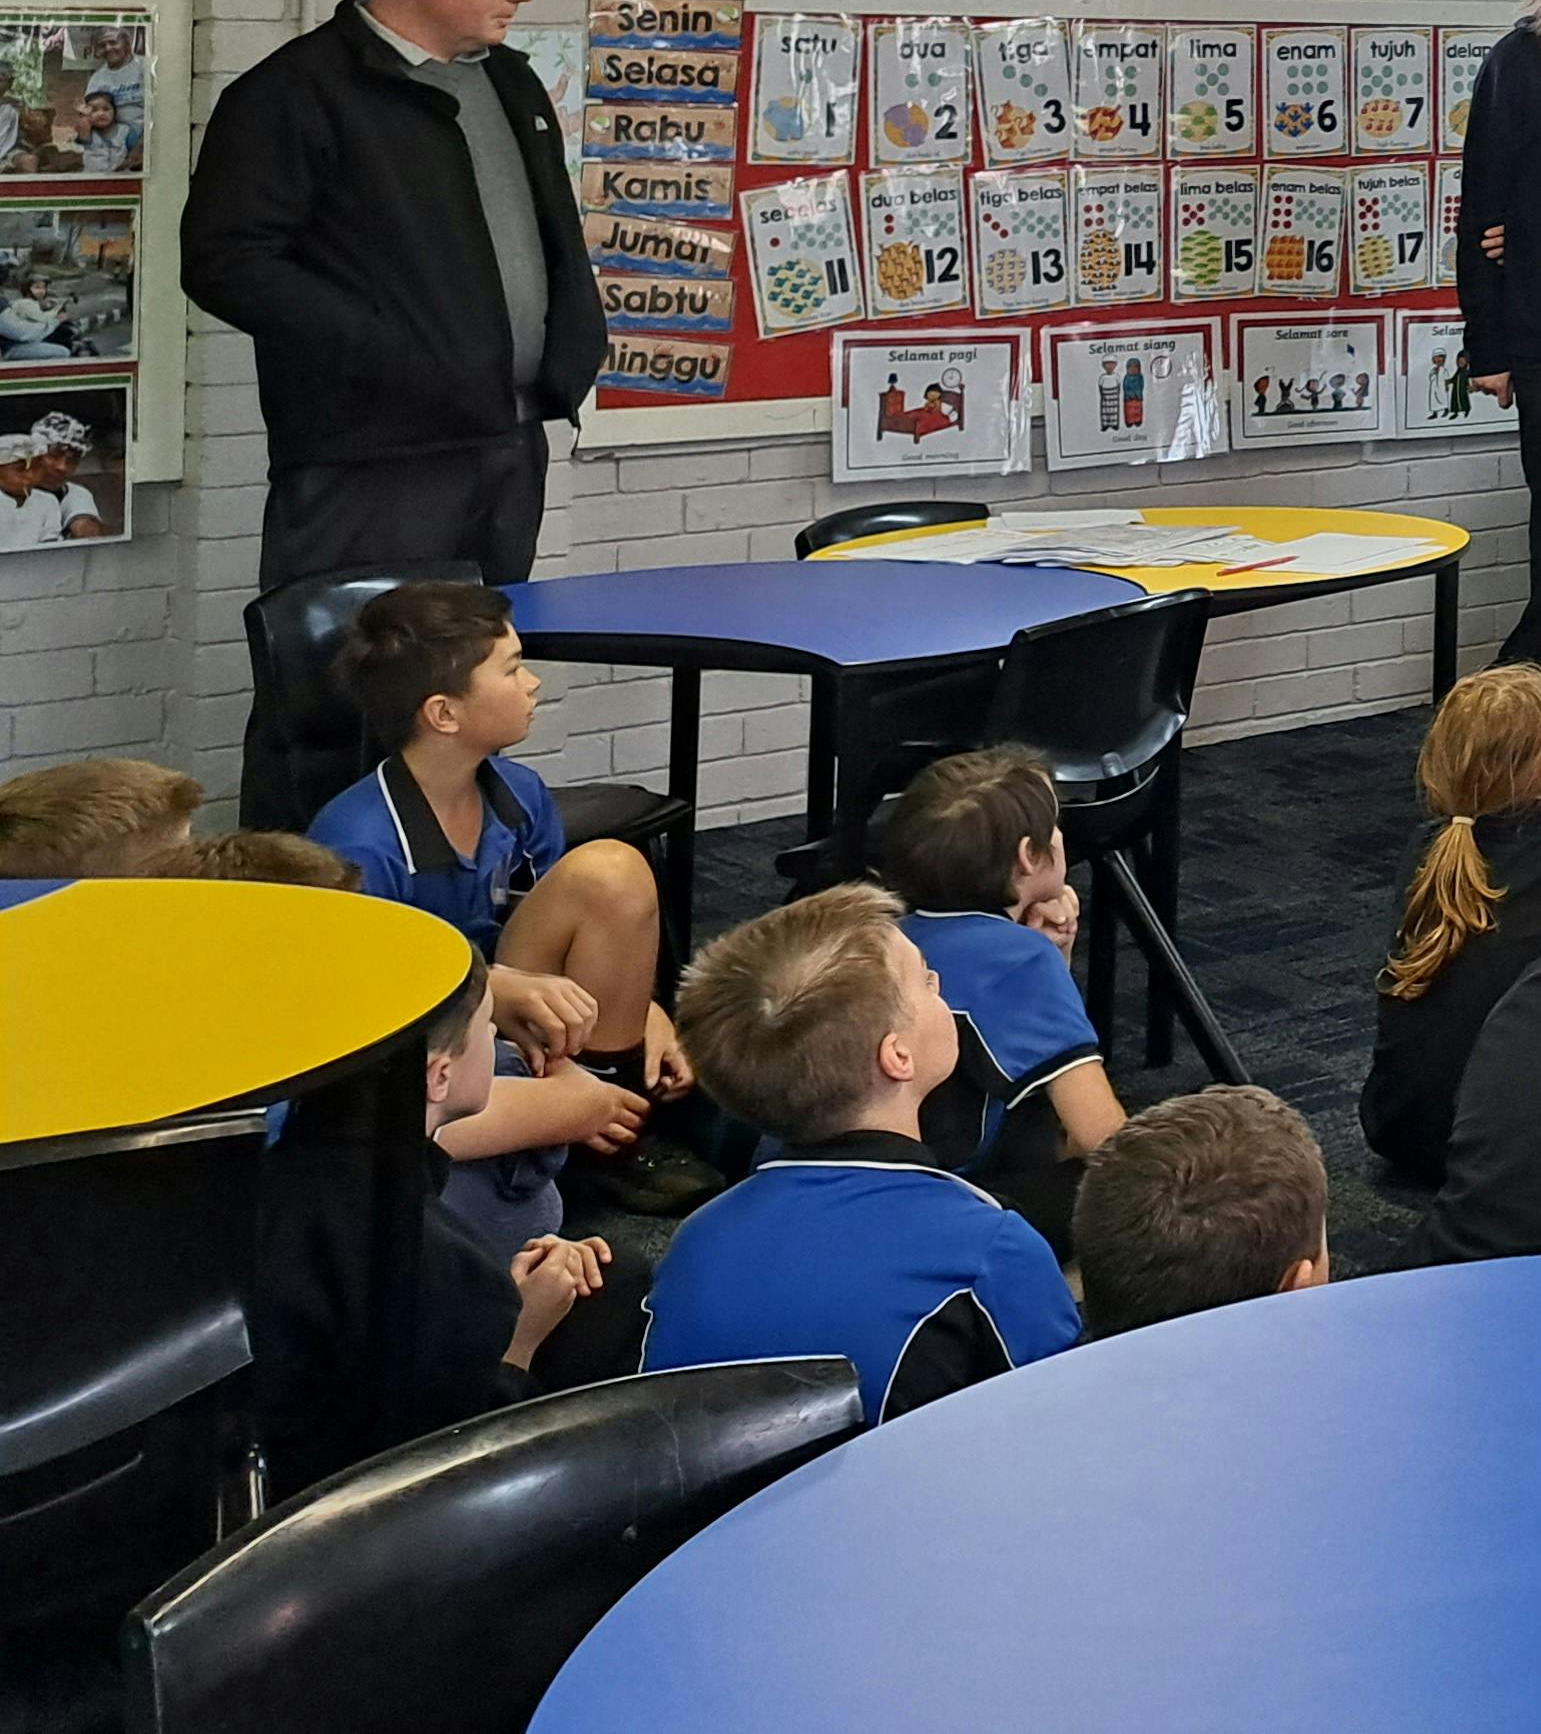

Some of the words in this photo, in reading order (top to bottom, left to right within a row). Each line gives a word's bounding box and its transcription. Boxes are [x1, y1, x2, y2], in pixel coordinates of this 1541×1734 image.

[617, 3, 713, 32] Senin
[1083, 39, 1158, 63] empat
[1189, 39, 1238, 59] lima
[1276, 44, 1336, 61] enam
[1370, 39, 1416, 62] tujuh
[604, 54, 720, 88] Selasa
[614, 114, 705, 143] Rabu
[933, 104, 958, 140] 2
[1043, 99, 1067, 134] 3
[1129, 102, 1151, 136] 4
[1224, 98, 1245, 132] 5
[1317, 99, 1337, 133] 6
[1404, 97, 1424, 129] 7
[602, 170, 712, 201] Kamis
[871, 192, 905, 209] dua
[910, 187, 957, 205] belas
[1018, 186, 1063, 204] belas
[1124, 182, 1158, 194] belas
[1180, 181, 1212, 196] lima
[1215, 180, 1254, 195] belas
[1271, 181, 1306, 194] enam
[1309, 182, 1342, 196] belas
[1358, 177, 1388, 190] tujuh
[1389, 175, 1421, 188] belas
[1123, 241, 1157, 277] 14
[1224, 238, 1253, 273] 15
[1306, 240, 1334, 273] 16
[1397, 231, 1425, 266] 17
[825, 257, 850, 296] 11
[924, 246, 960, 284] 12
[1031, 248, 1065, 286] 13
[604, 283, 709, 315] Sabtu
[1088, 341, 1141, 355] Selamat
[1143, 338, 1176, 354] siang
[1275, 329, 1322, 341] Selamat
[888, 349, 946, 363] Selamat
[948, 347, 978, 364] pagi
